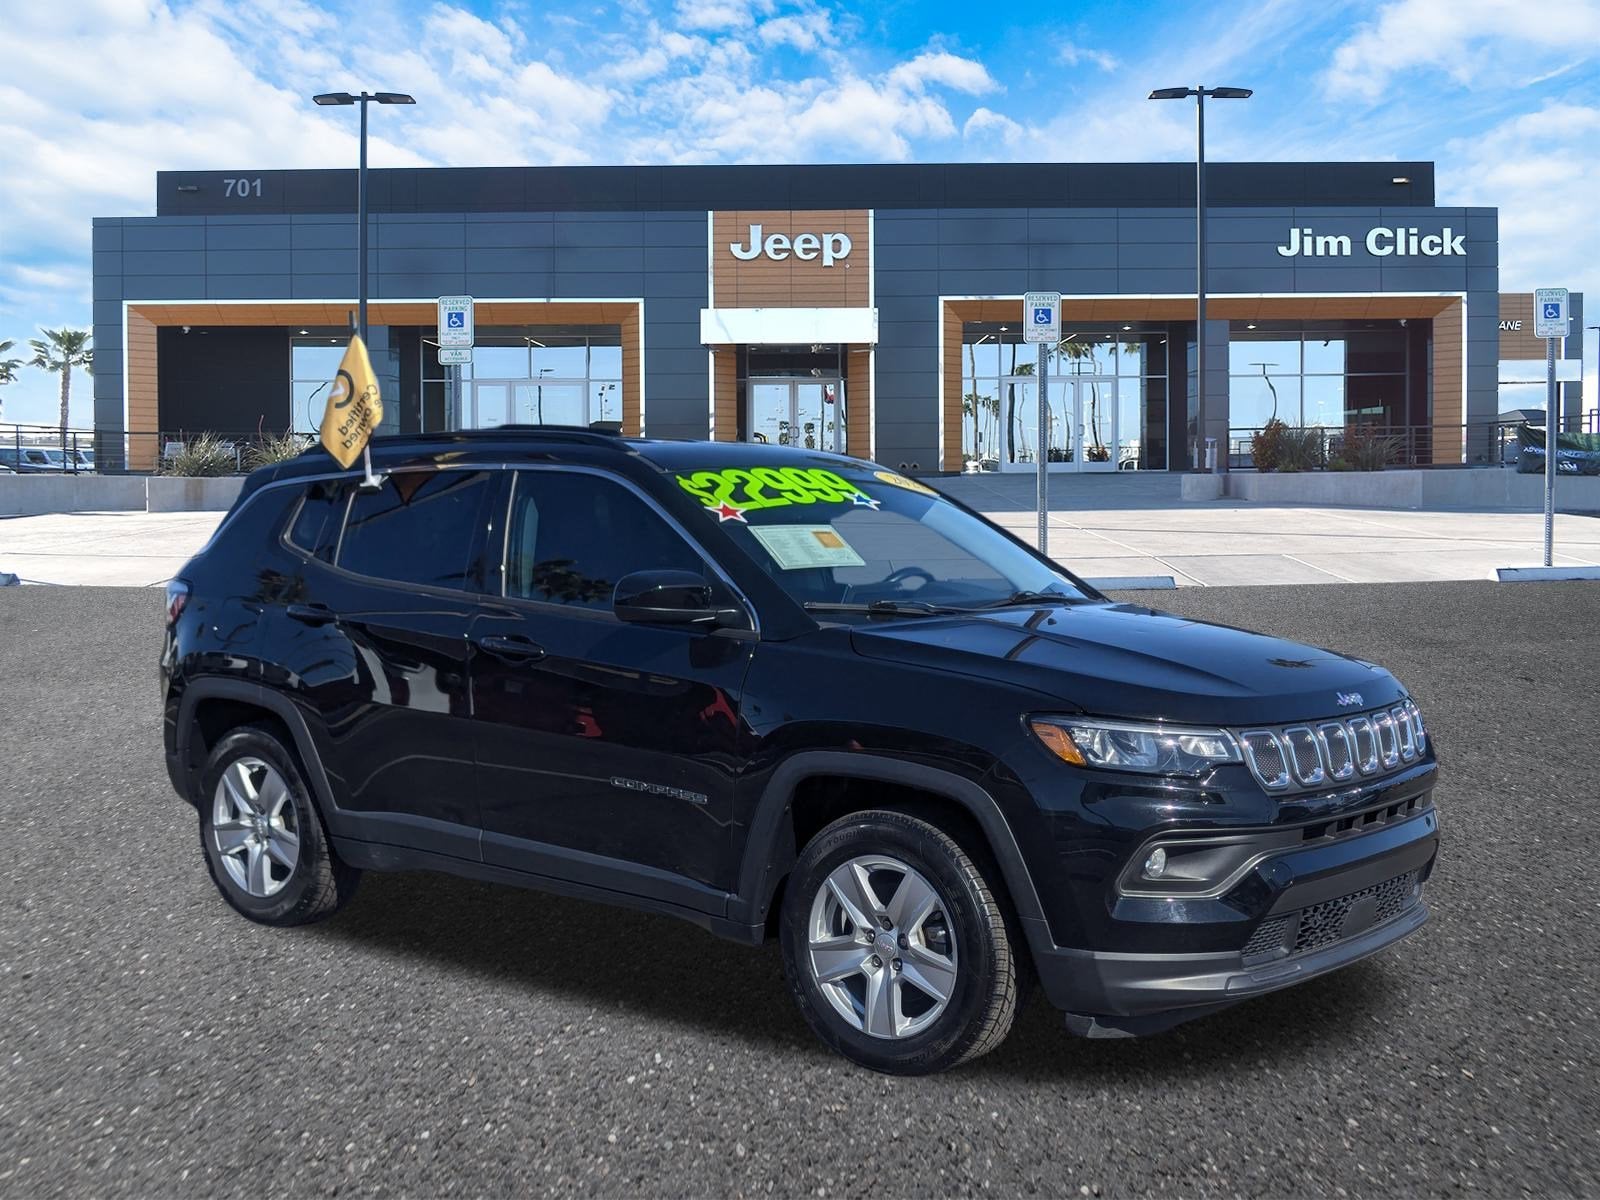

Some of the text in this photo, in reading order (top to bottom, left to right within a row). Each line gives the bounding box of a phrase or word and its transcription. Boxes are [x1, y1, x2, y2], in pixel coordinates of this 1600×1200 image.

[223, 178, 263, 198] 701
[729, 223, 852, 268] Jeep
[1277, 227, 1467, 257] Jim Click
[676, 467, 870, 510] $22999
